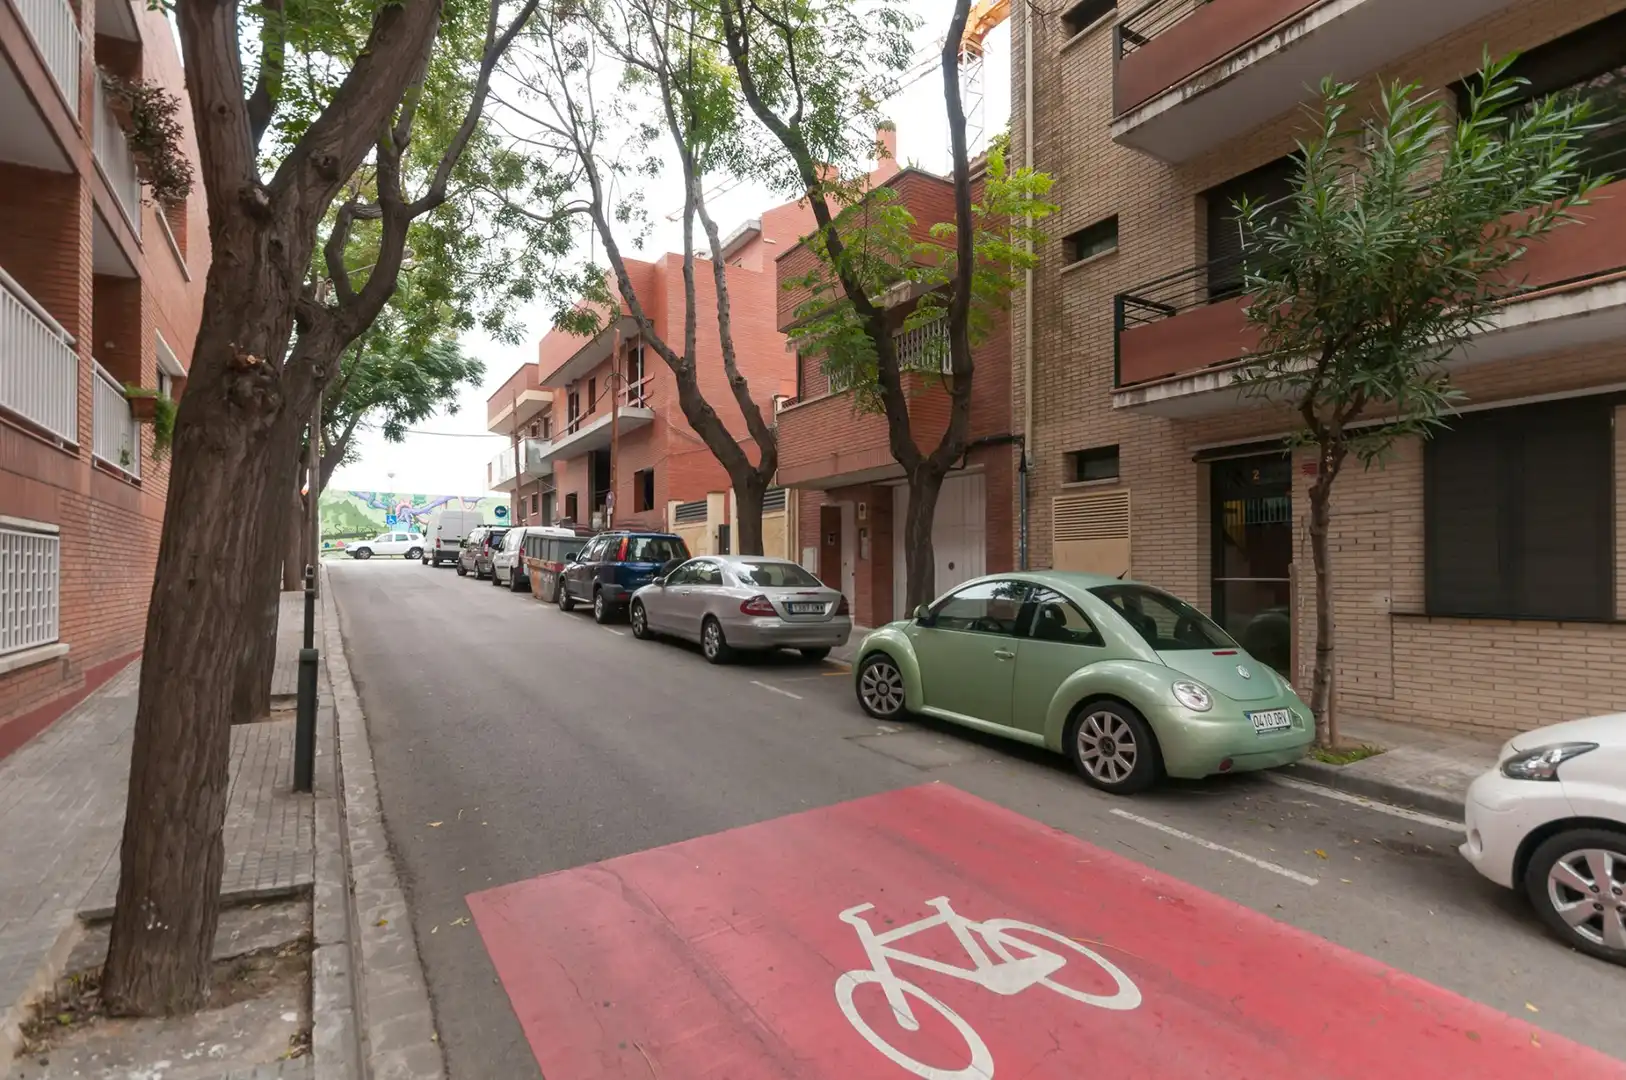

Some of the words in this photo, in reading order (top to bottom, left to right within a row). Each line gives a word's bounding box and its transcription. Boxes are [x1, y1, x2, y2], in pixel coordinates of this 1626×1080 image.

[1251, 469, 1260, 480] 2
[1253, 713, 1273, 728] 0410
[1274, 711, 1287, 725] DRV
